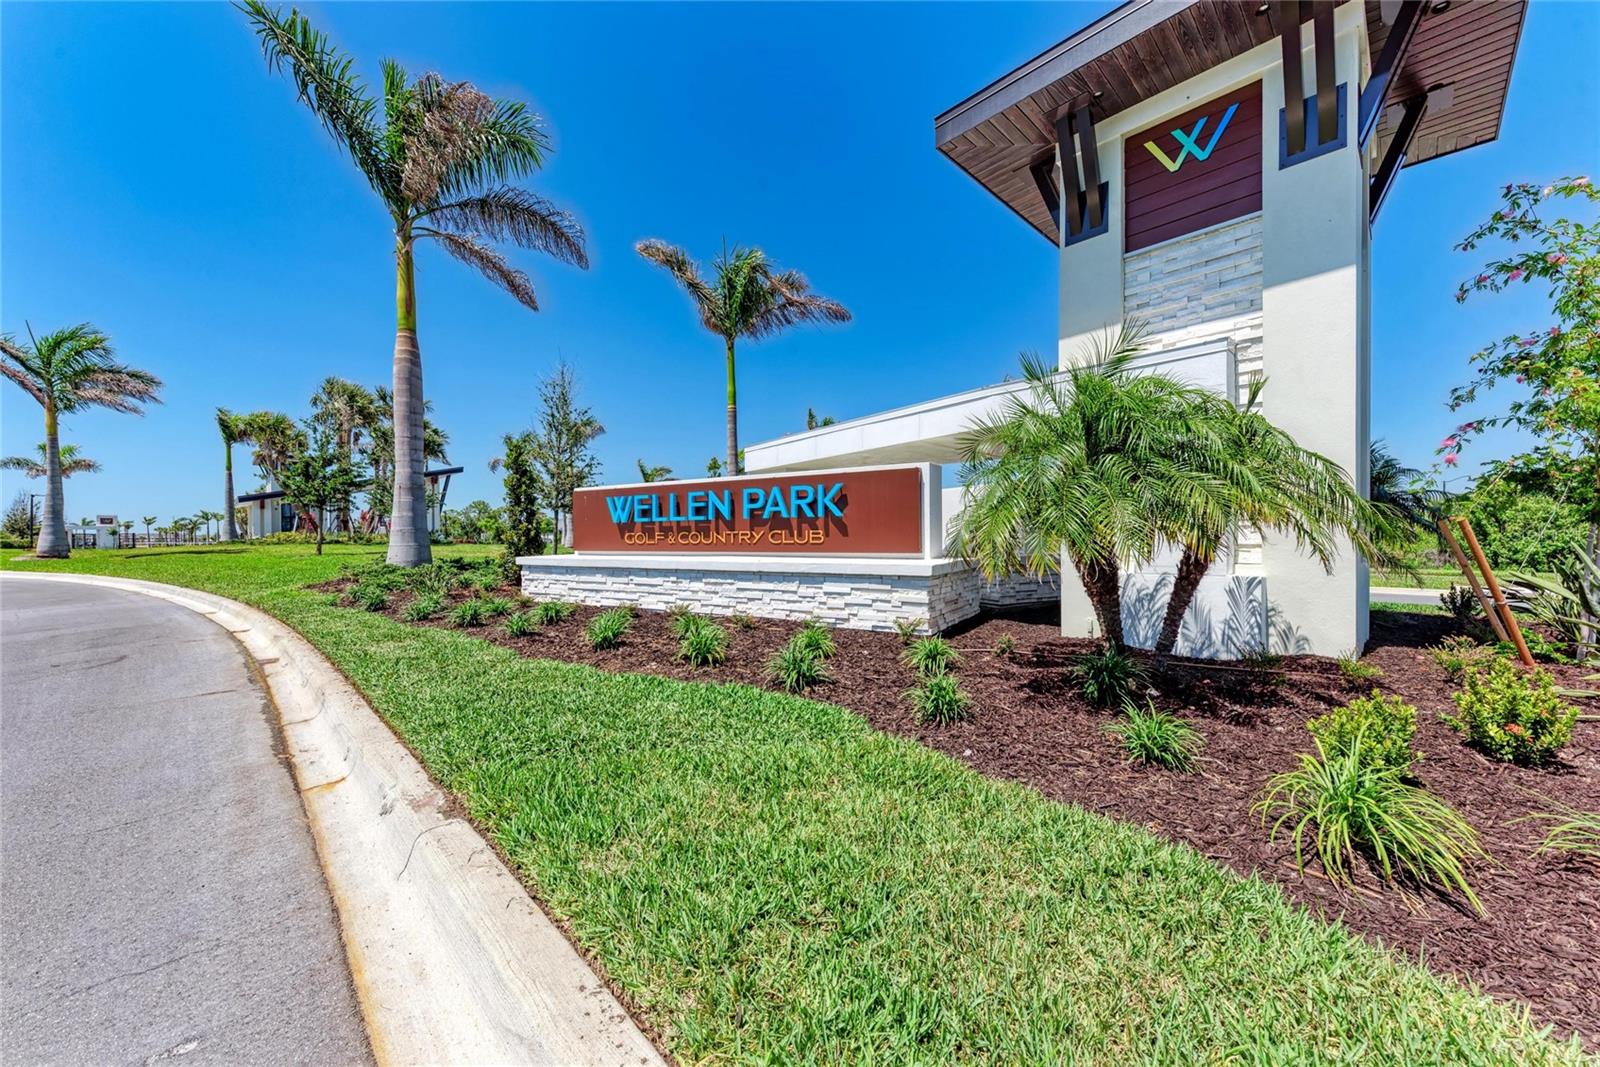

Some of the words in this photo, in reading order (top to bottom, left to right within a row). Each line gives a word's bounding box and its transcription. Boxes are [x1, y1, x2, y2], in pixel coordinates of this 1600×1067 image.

[606, 489, 731, 524] WELLEN
[742, 482, 844, 519] PARK
[624, 531, 665, 544] GOLF
[667, 532, 676, 544] &
[678, 530, 764, 545] COUNTRY
[768, 530, 824, 544] CLUB
